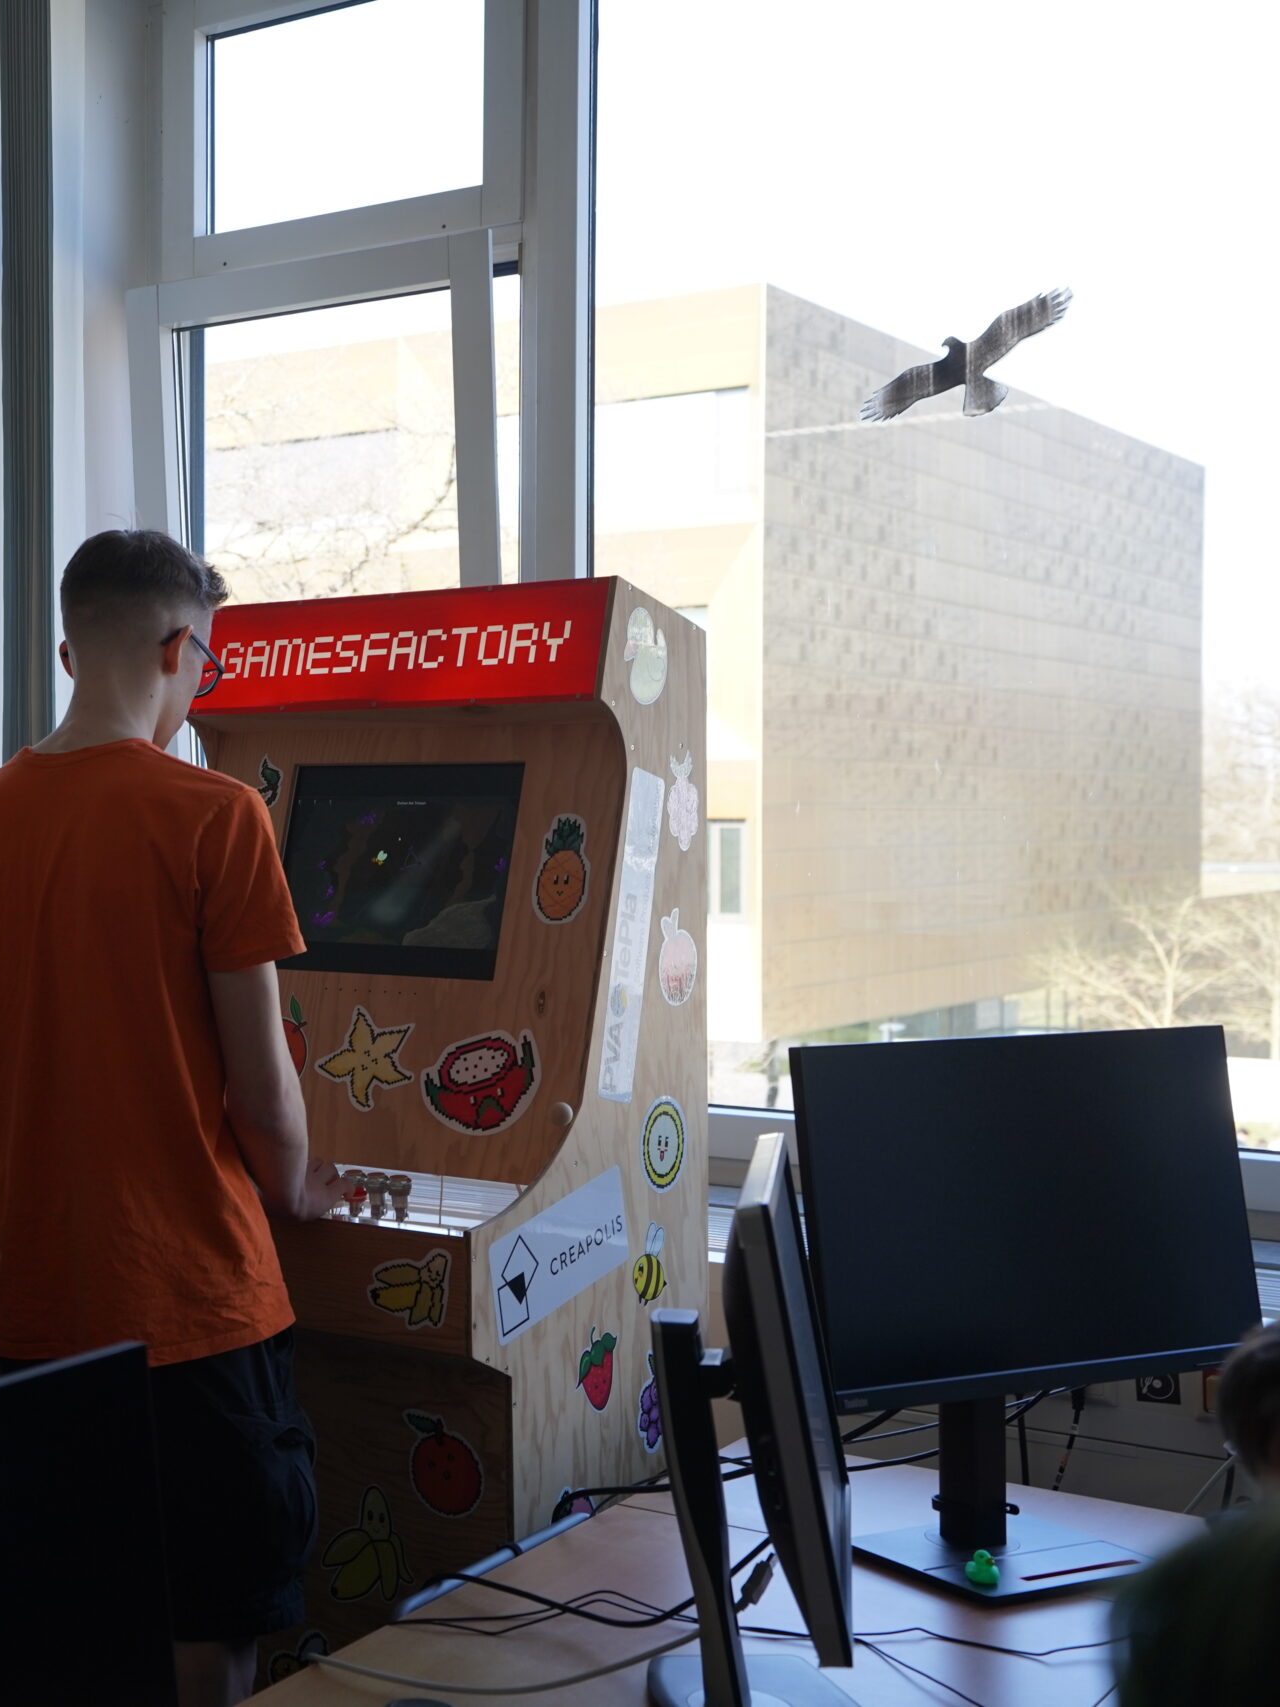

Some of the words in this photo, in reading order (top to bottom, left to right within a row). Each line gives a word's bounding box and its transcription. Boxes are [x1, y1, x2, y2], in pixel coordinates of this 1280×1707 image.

[221, 620, 572, 680] GAMESFACTORY
[601, 1022, 624, 1092] PVA
[614, 892, 638, 980] TePla
[550, 1215, 623, 1275] CREAPOLIS
